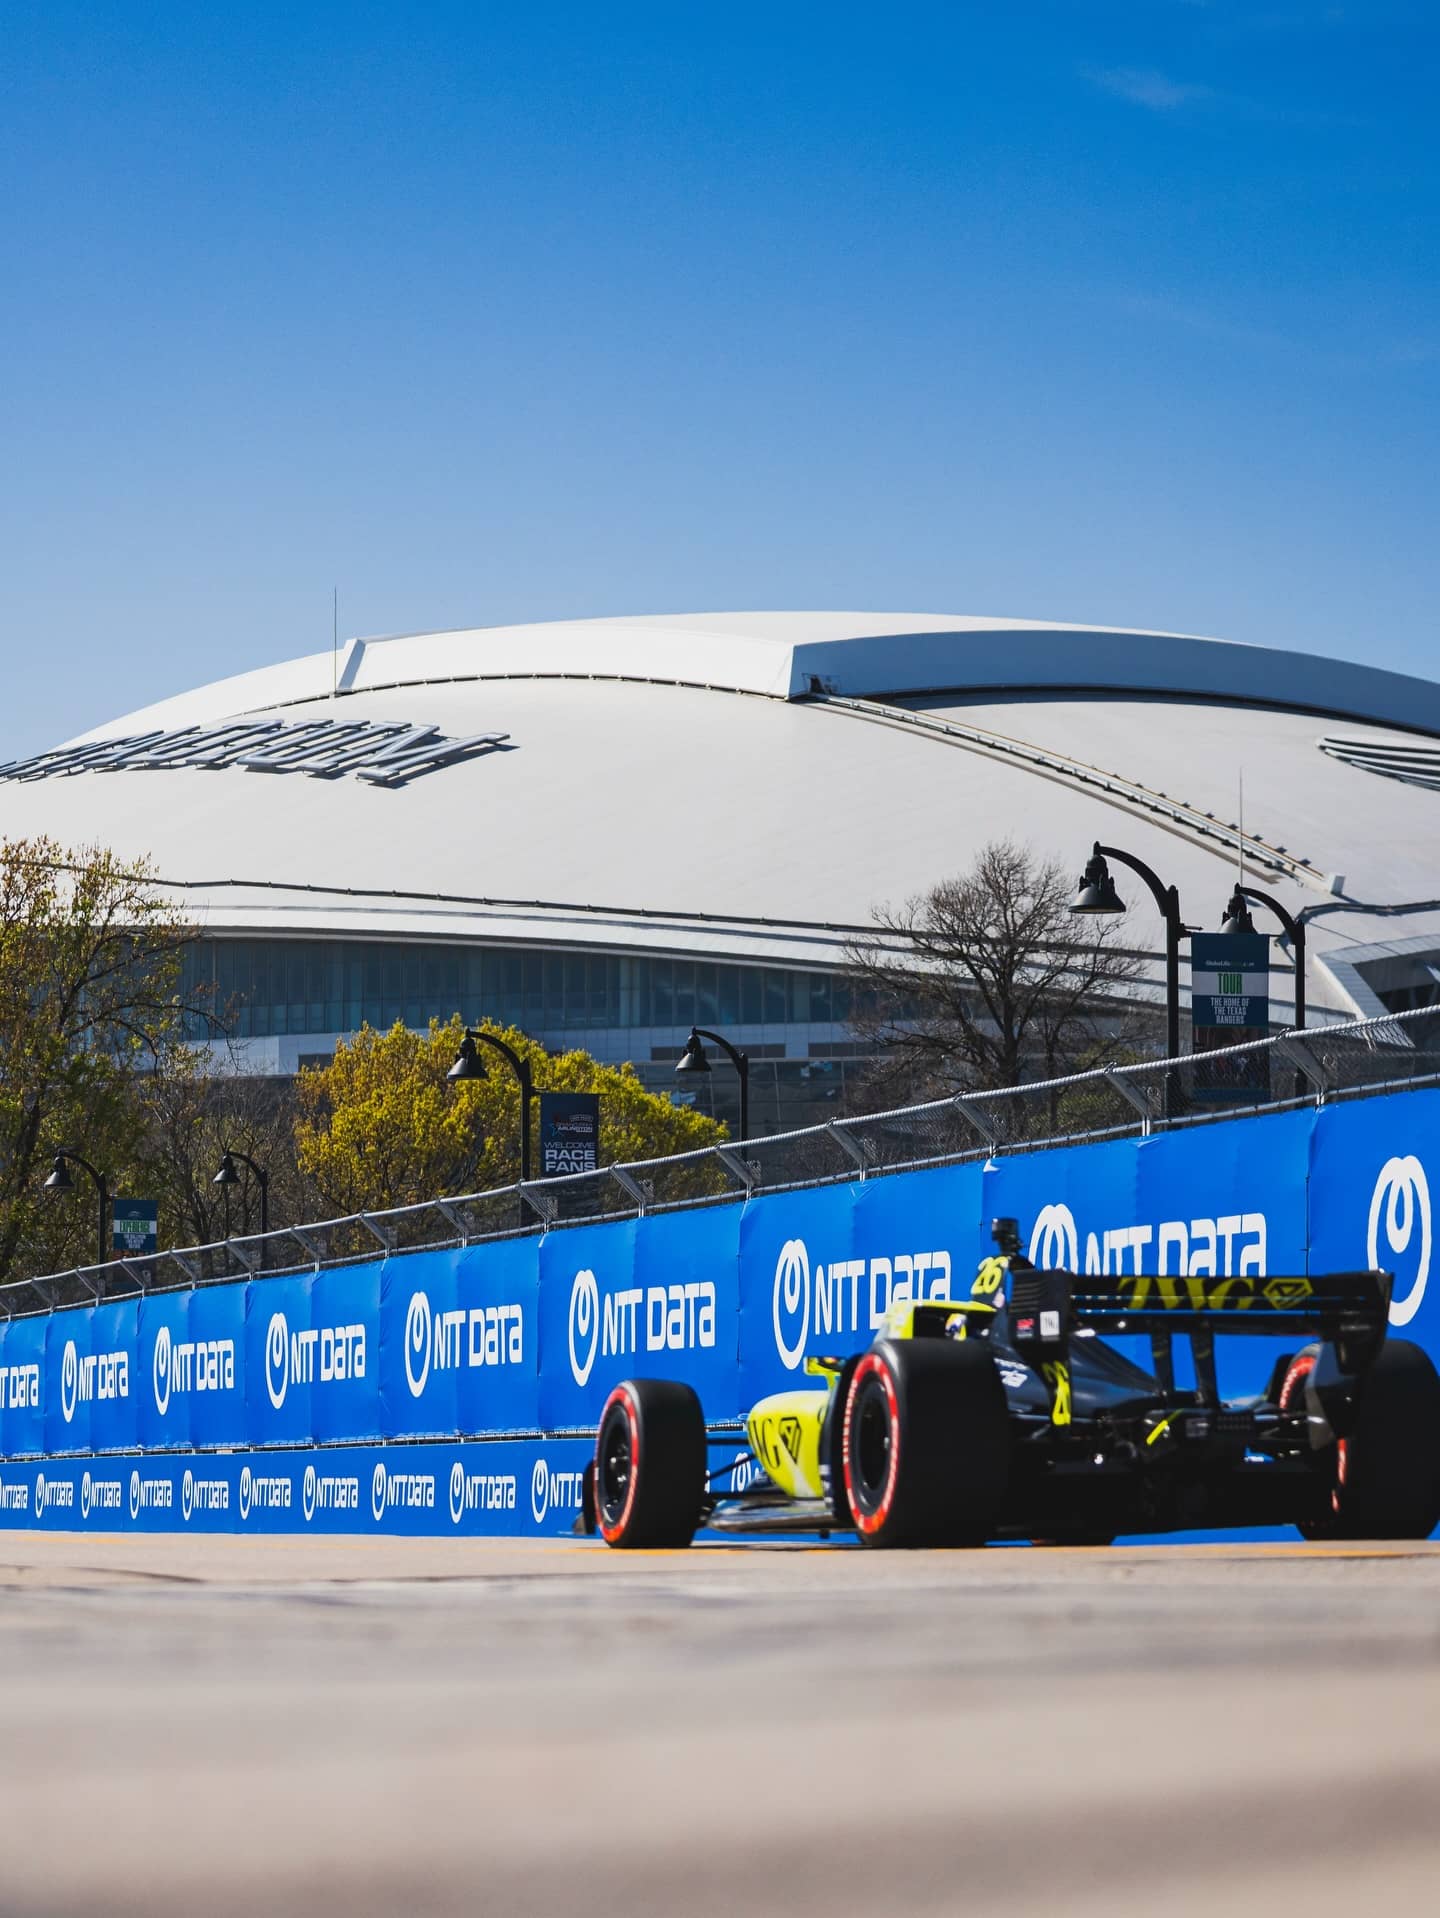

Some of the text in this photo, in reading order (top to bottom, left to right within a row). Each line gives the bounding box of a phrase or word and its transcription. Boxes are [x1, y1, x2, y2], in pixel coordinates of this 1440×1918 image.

[1211, 997, 1249, 1007] THE HOME OF
[1218, 973, 1243, 995] TOUR
[1214, 1006, 1247, 1016] THE TEXAS
[544, 1142, 596, 1150] WELCOME
[545, 1149, 596, 1160] RACE
[545, 1161, 596, 1173] FANS
[814, 1250, 951, 1335] NTT DATA
[970, 1256, 1011, 1295] 26
[433, 1303, 523, 1370] NTT DATA
[602, 1281, 716, 1356] NTT DATA
[171, 1339, 235, 1393] NTT DATA
[291, 1323, 366, 1385] NTT DATA
[9, 1363, 39, 1409] DATA
[78, 1351, 129, 1401] NTT DATA
